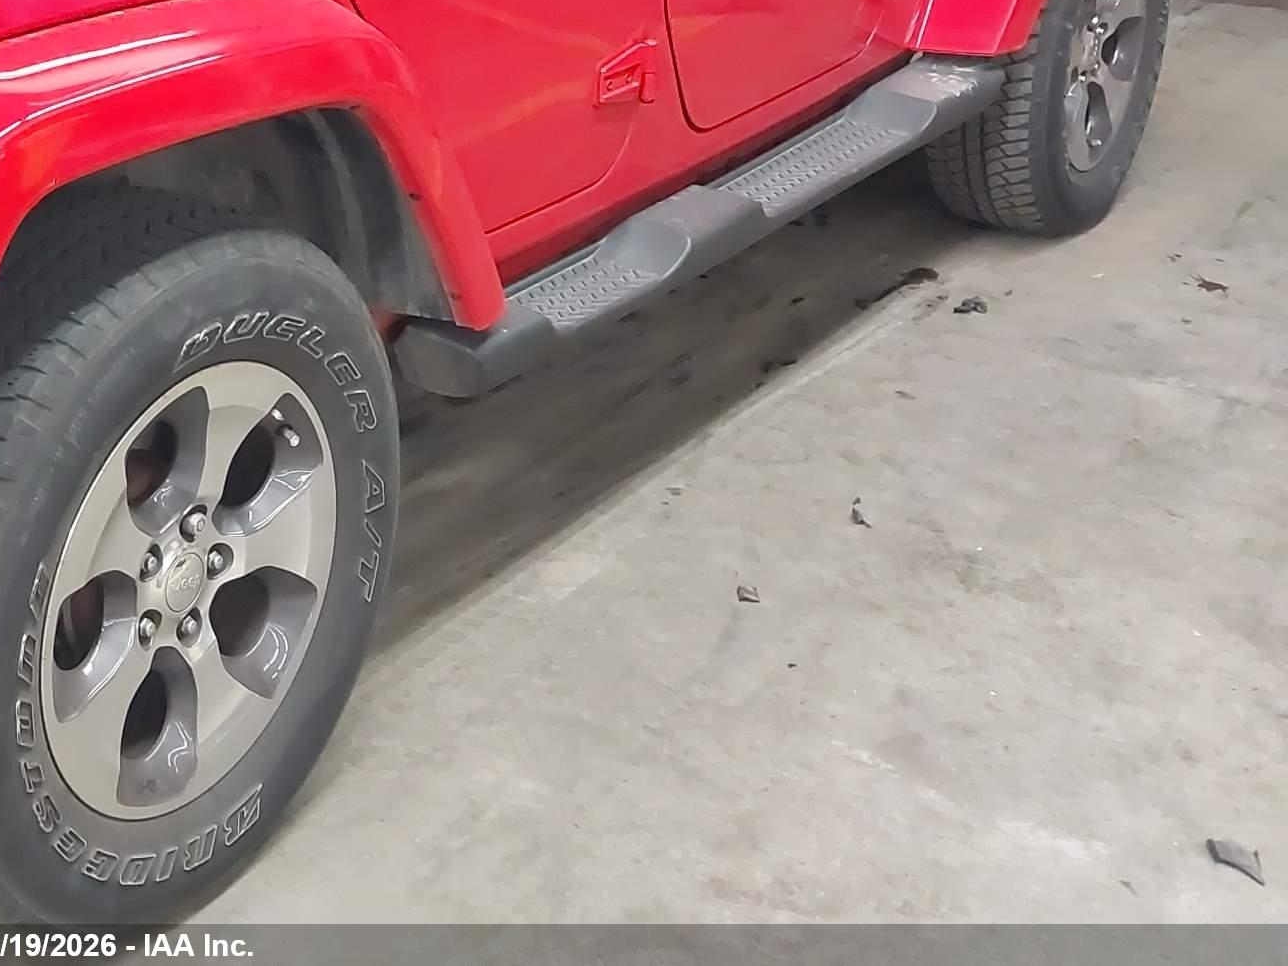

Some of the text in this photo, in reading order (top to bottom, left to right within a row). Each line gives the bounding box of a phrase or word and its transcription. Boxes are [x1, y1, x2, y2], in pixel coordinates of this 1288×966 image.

[172, 310, 386, 603] DUELER A/T
[15, 560, 264, 886] BRIDGESTONE
